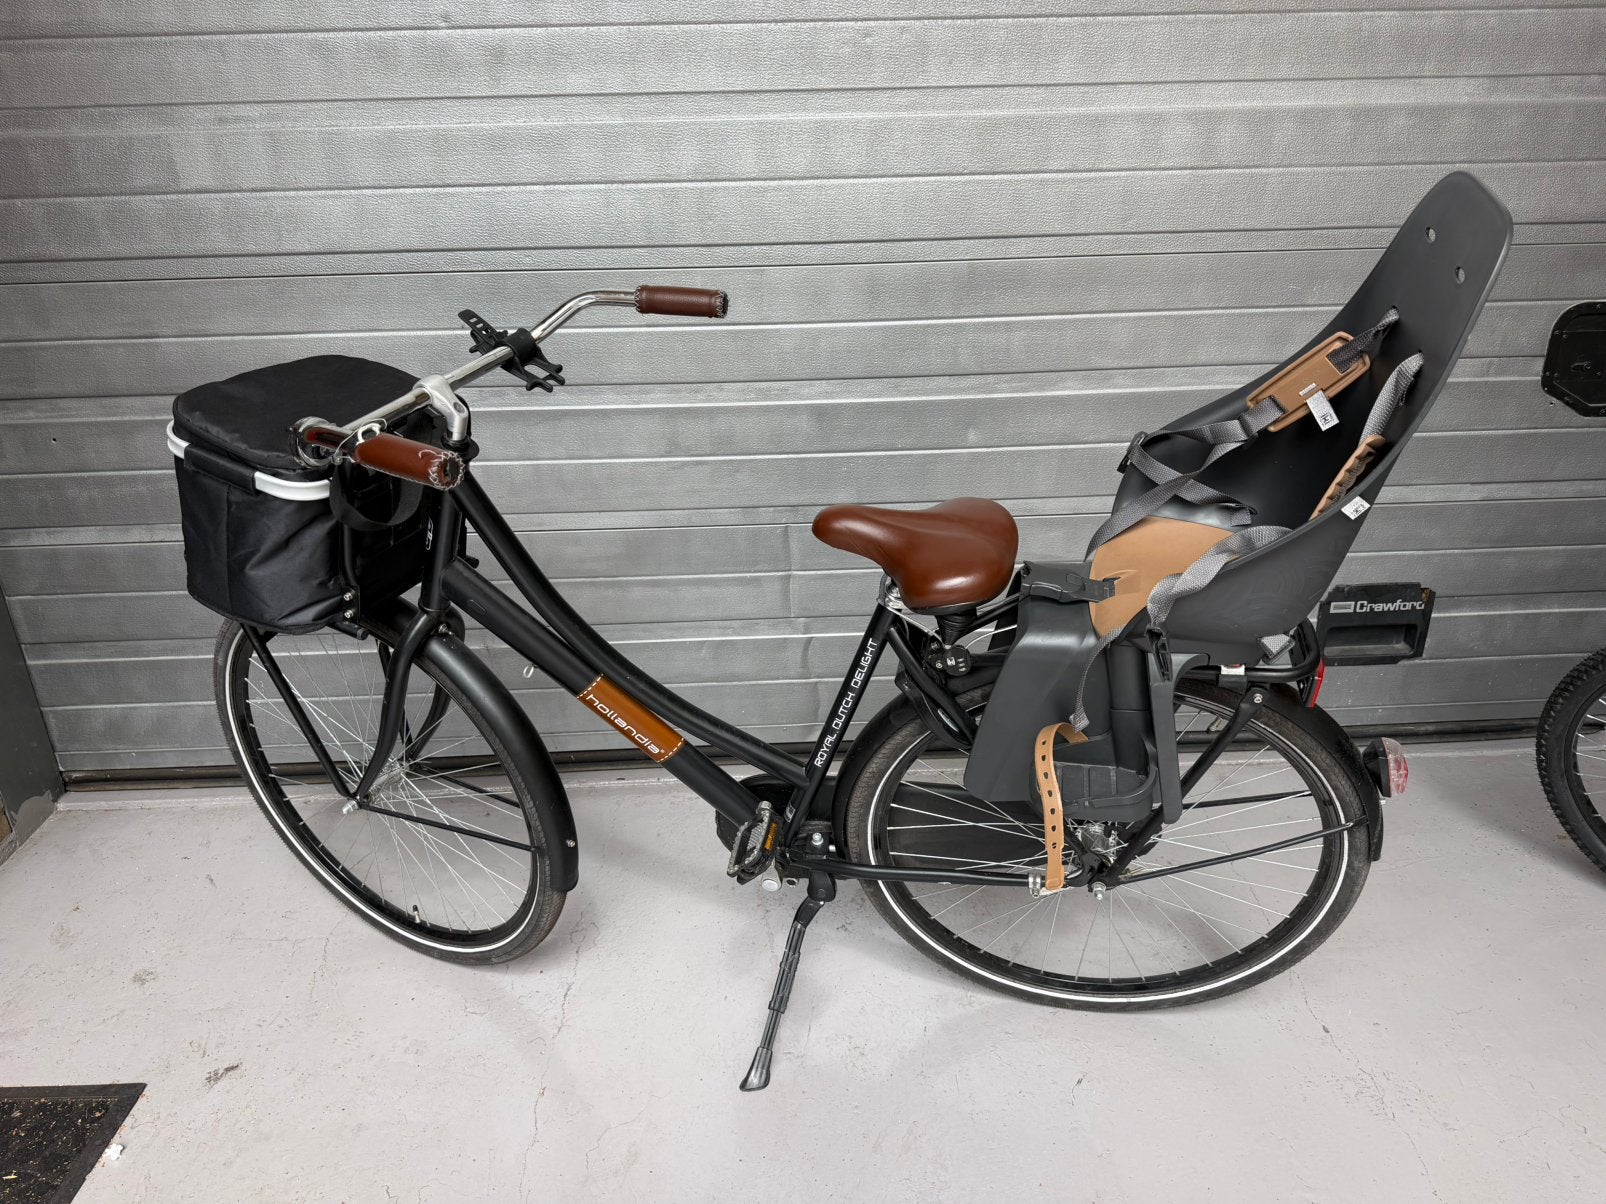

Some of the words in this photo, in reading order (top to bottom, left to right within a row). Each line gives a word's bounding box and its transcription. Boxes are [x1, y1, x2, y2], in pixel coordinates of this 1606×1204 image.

[832, 691, 856, 730] DUTCH
[851, 637, 878, 689] DELIGHT
[586, 693, 660, 754] hollandia
